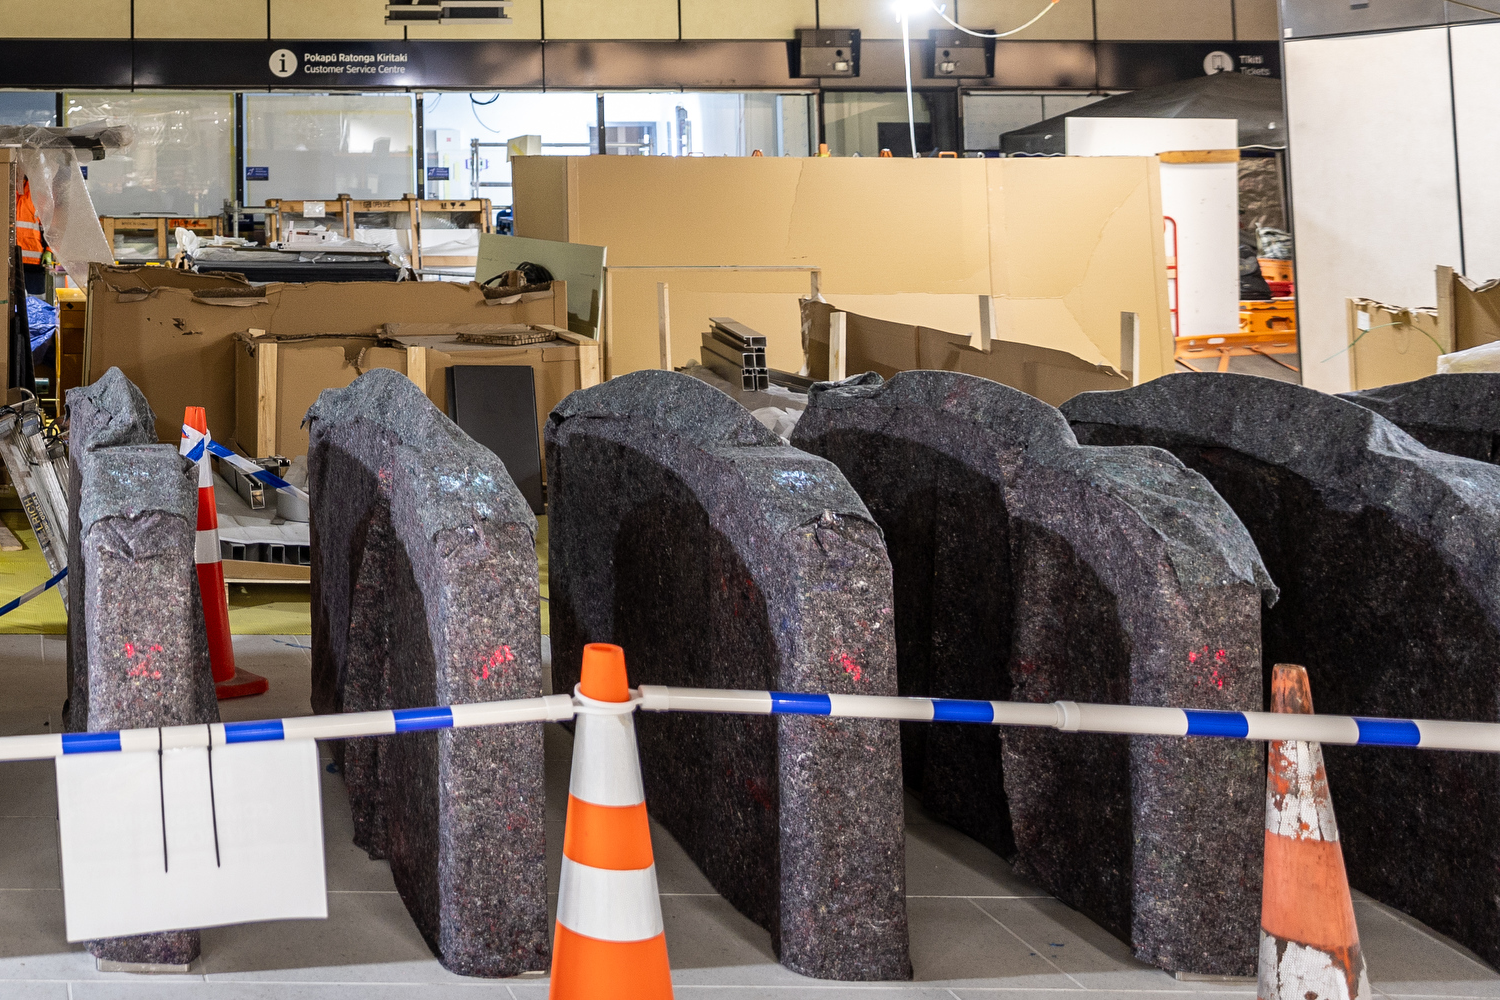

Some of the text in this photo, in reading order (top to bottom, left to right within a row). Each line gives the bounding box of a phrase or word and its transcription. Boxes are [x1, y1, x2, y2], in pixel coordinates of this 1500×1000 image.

[304, 53, 408, 63] Pokapū Ratonga Kiritaki
[304, 65, 406, 74] Customer Service Centre
